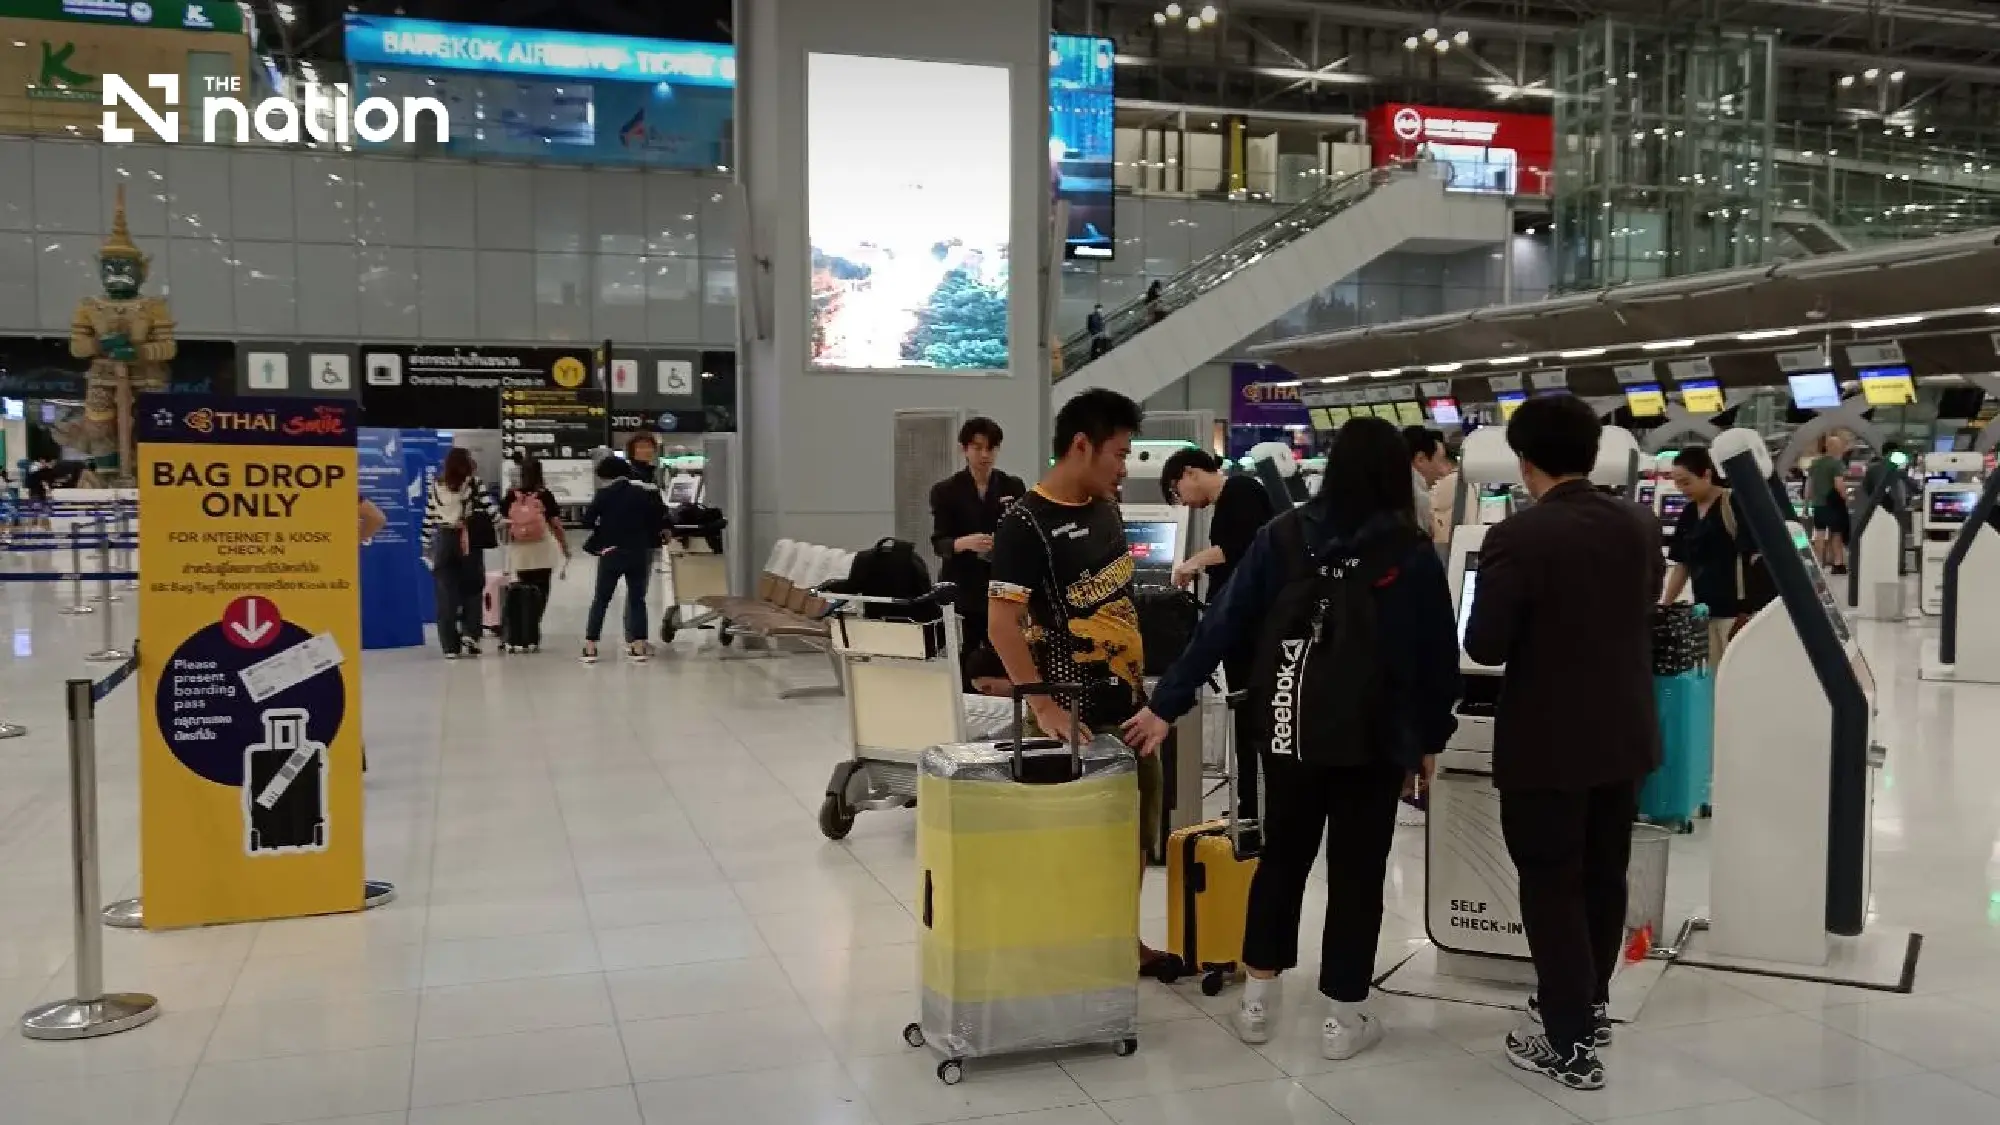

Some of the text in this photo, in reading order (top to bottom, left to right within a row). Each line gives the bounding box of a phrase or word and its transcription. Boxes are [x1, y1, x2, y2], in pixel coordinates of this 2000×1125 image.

[1264, 384, 1302, 400] THA
[215, 411, 277, 431] THAI
[152, 461, 232, 488] BAG
[244, 463, 346, 489] DROP
[202, 492, 301, 518] ONLY
[168, 531, 332, 543] FOR INTERNET & KIOSK
[217, 544, 286, 556] CHECK-IN
[174, 659, 217, 669] Please
[174, 673, 225, 684] present
[174, 683, 235, 696] boarding
[174, 700, 206, 711] pass
[1271, 664, 1296, 754] Reebok
[1450, 899, 1488, 914] SELF
[1450, 916, 1524, 936] CHECK-IN
